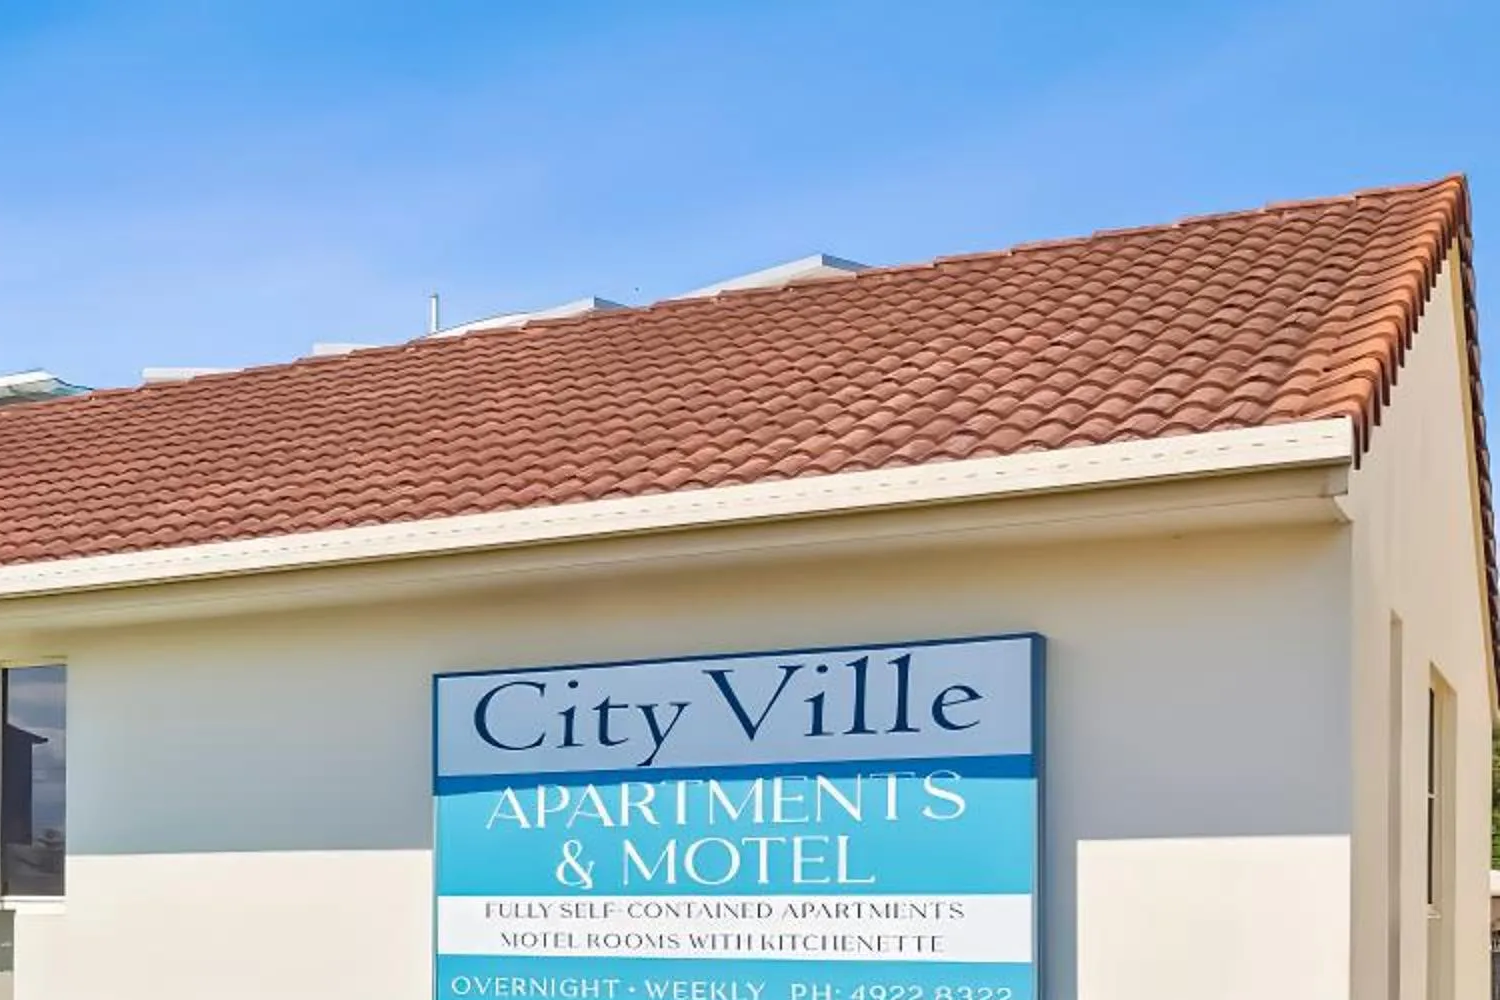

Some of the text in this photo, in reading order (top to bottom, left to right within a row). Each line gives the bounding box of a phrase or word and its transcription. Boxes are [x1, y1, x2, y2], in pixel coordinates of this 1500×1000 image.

[486, 770, 967, 830] APARTMENTS
[556, 835, 876, 890] & MOTEL
[485, 902, 551, 920] FULLY
[781, 902, 966, 920] APARTMENTS
[501, 932, 946, 953] MOTEL ROOMS WITH KITCHENETTE
[451, 975, 621, 1000] OVERNIGHT
